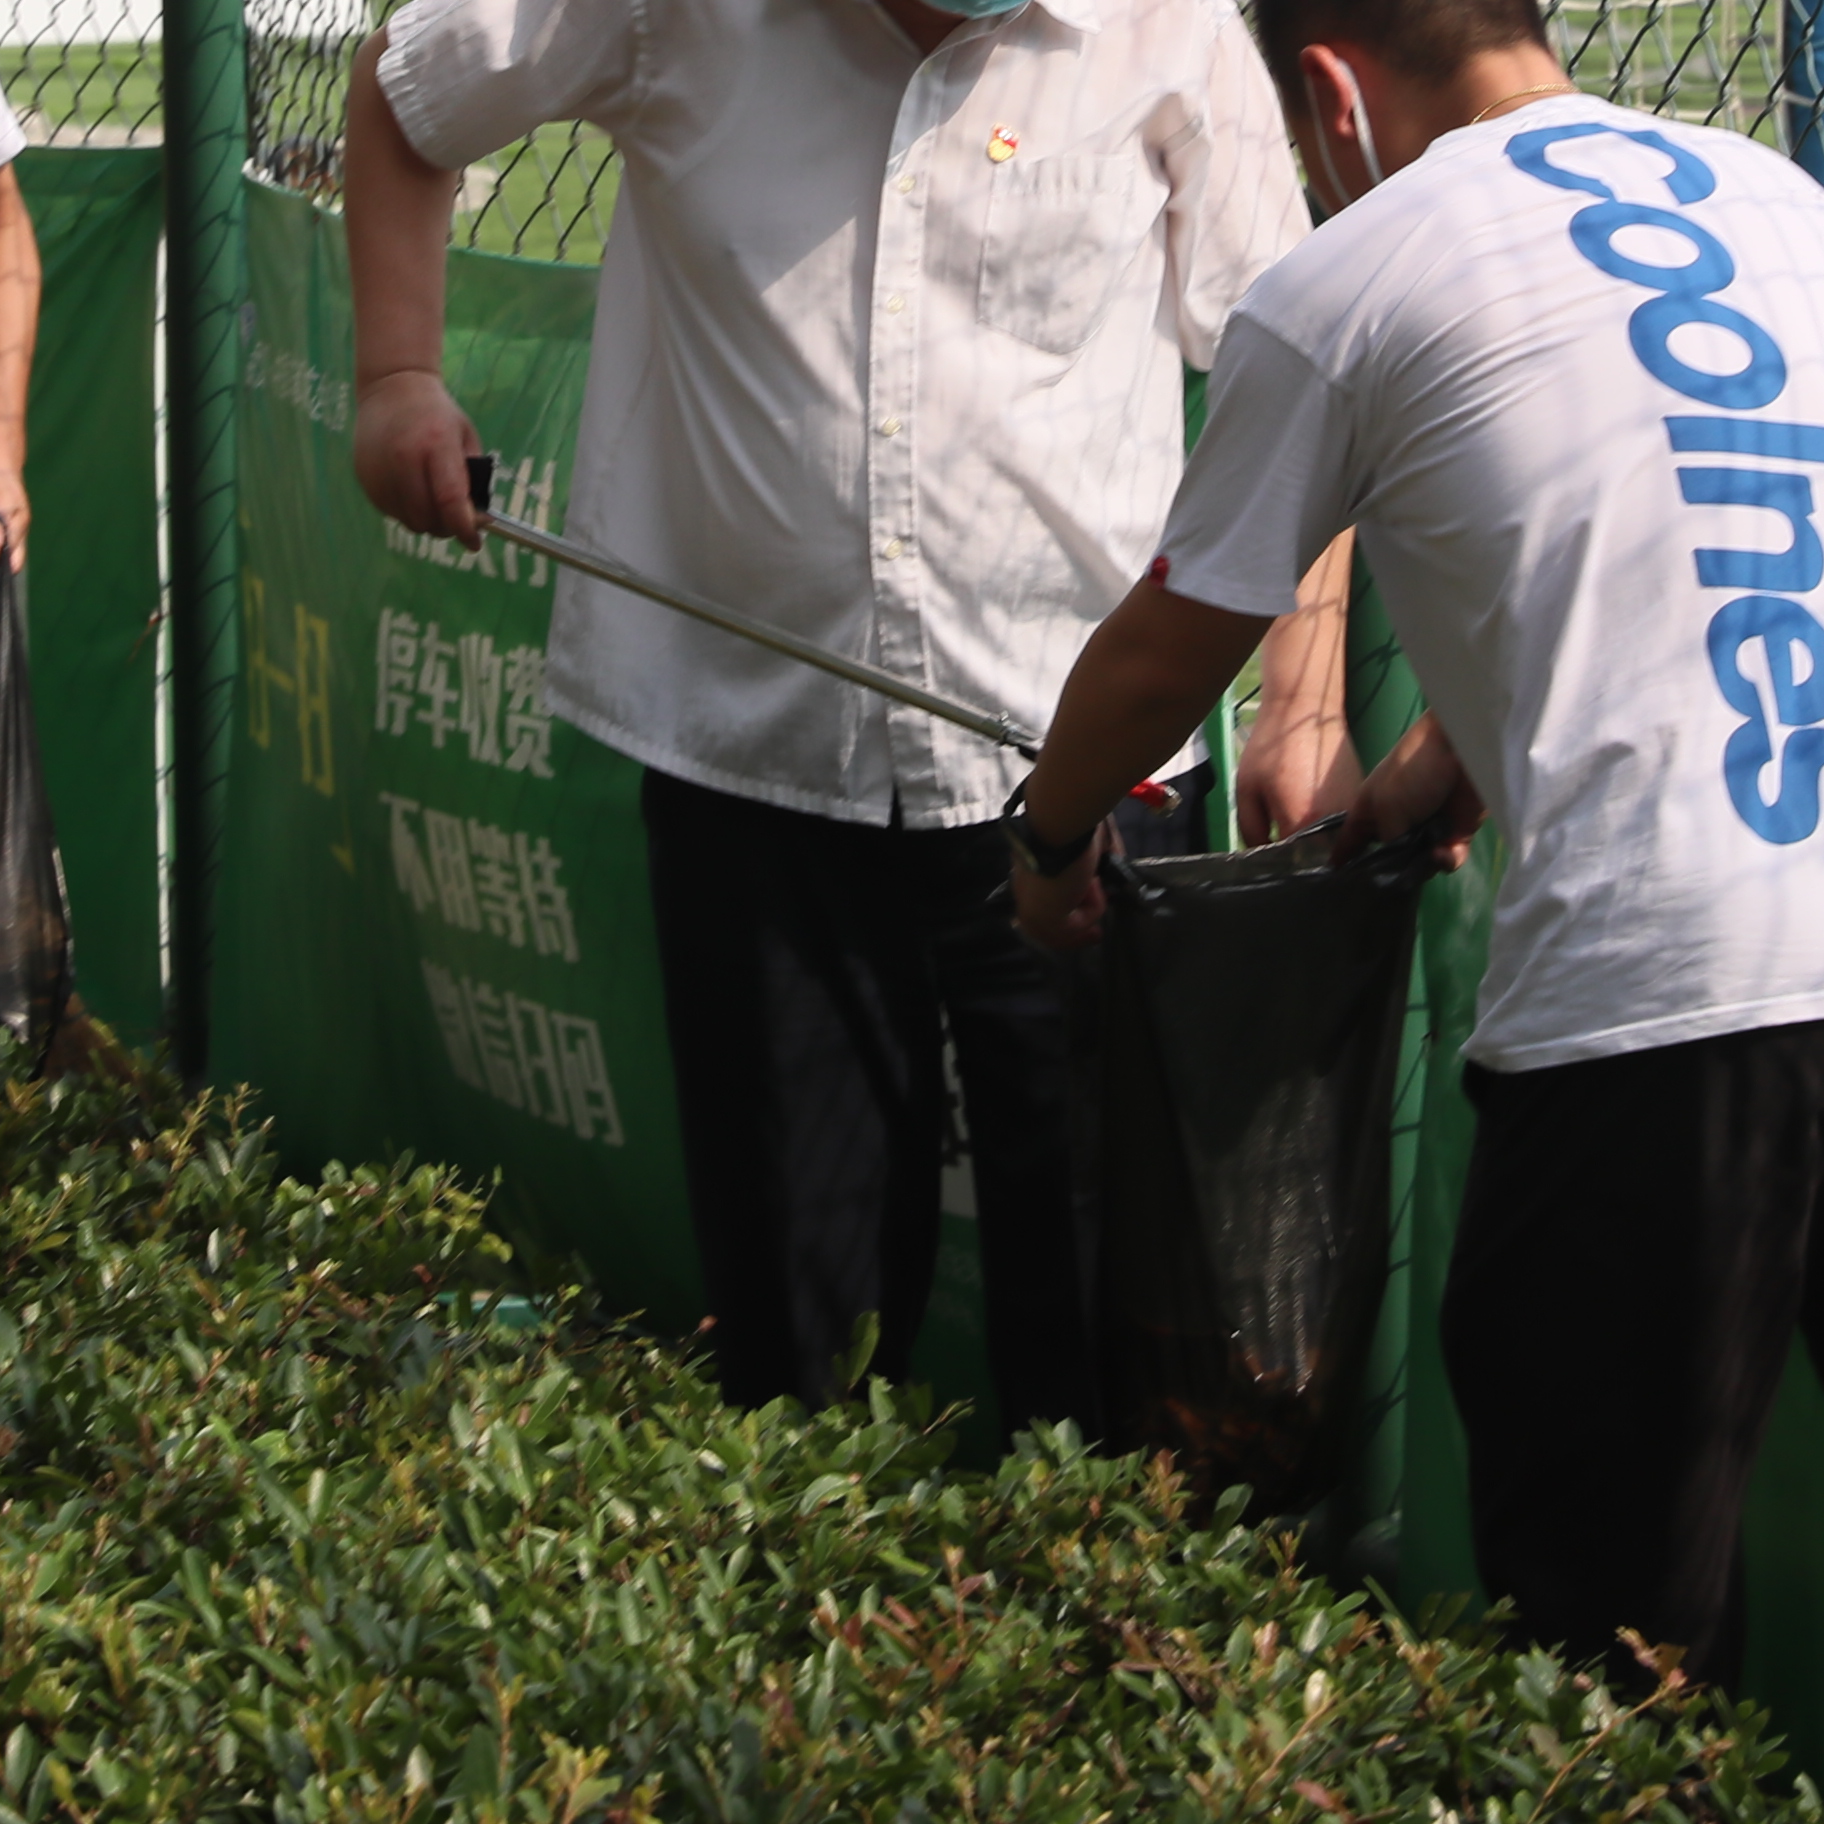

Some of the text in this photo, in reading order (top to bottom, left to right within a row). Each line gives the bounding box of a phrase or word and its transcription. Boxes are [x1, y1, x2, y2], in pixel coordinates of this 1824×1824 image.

[376, 606, 554, 780] 停车收费
[379, 790, 580, 964] 不用等待
